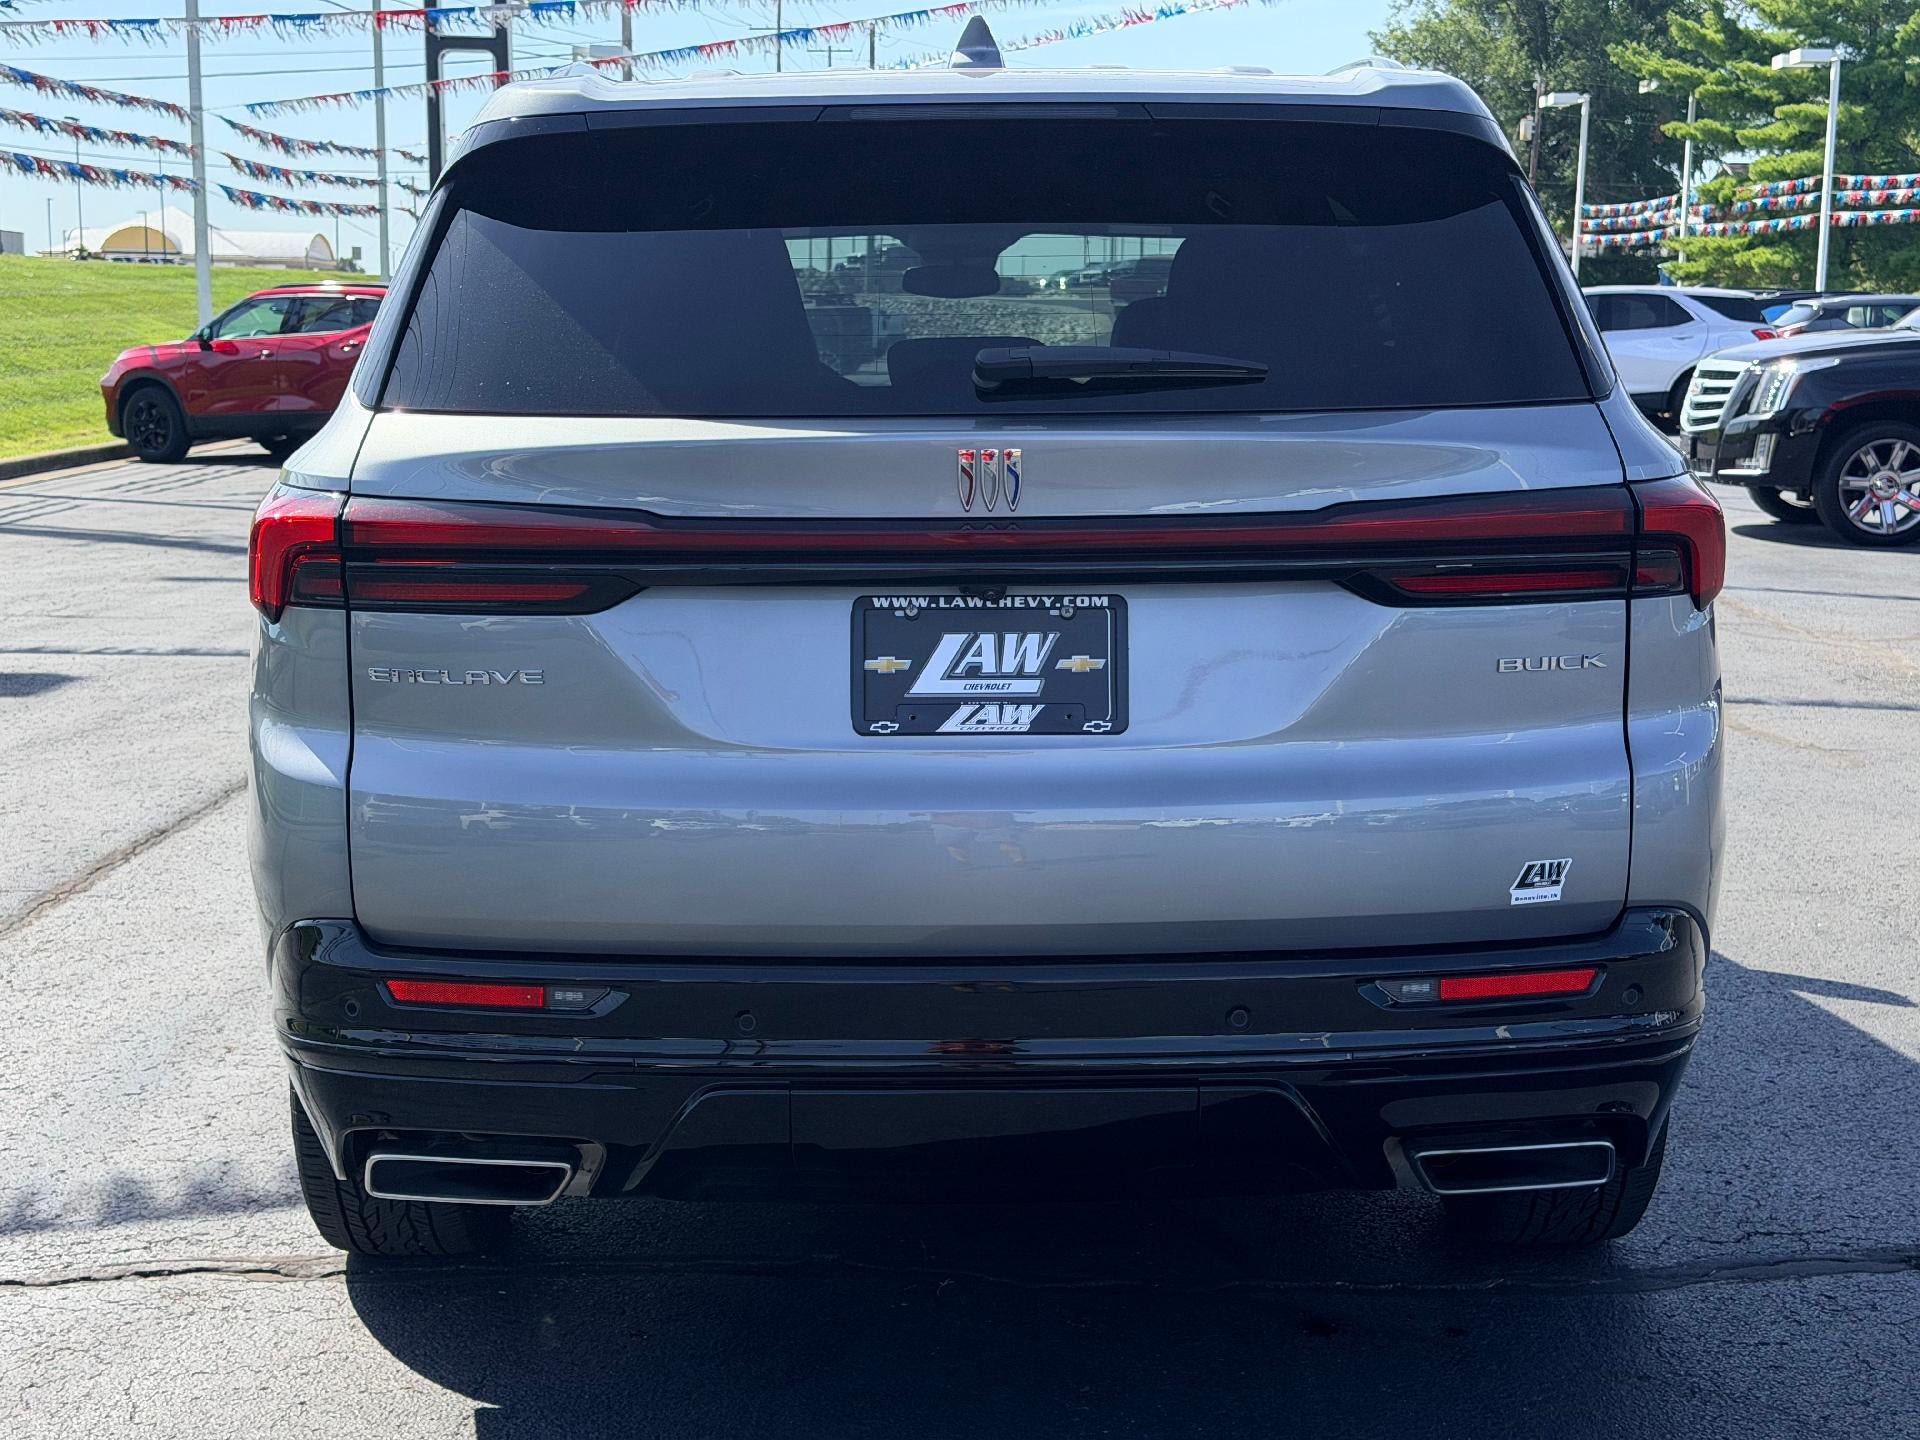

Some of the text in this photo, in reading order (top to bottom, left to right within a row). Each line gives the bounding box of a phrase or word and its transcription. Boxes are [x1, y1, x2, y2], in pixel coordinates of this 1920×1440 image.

[872, 597, 1108, 608] WWW.LAWCHEVY.COM
[905, 632, 1059, 697] LAW
[1498, 652, 1608, 673] BUICK
[367, 667, 544, 685] ENCLAVE
[936, 704, 1046, 732] LAW
[1513, 859, 1570, 890] LAW
